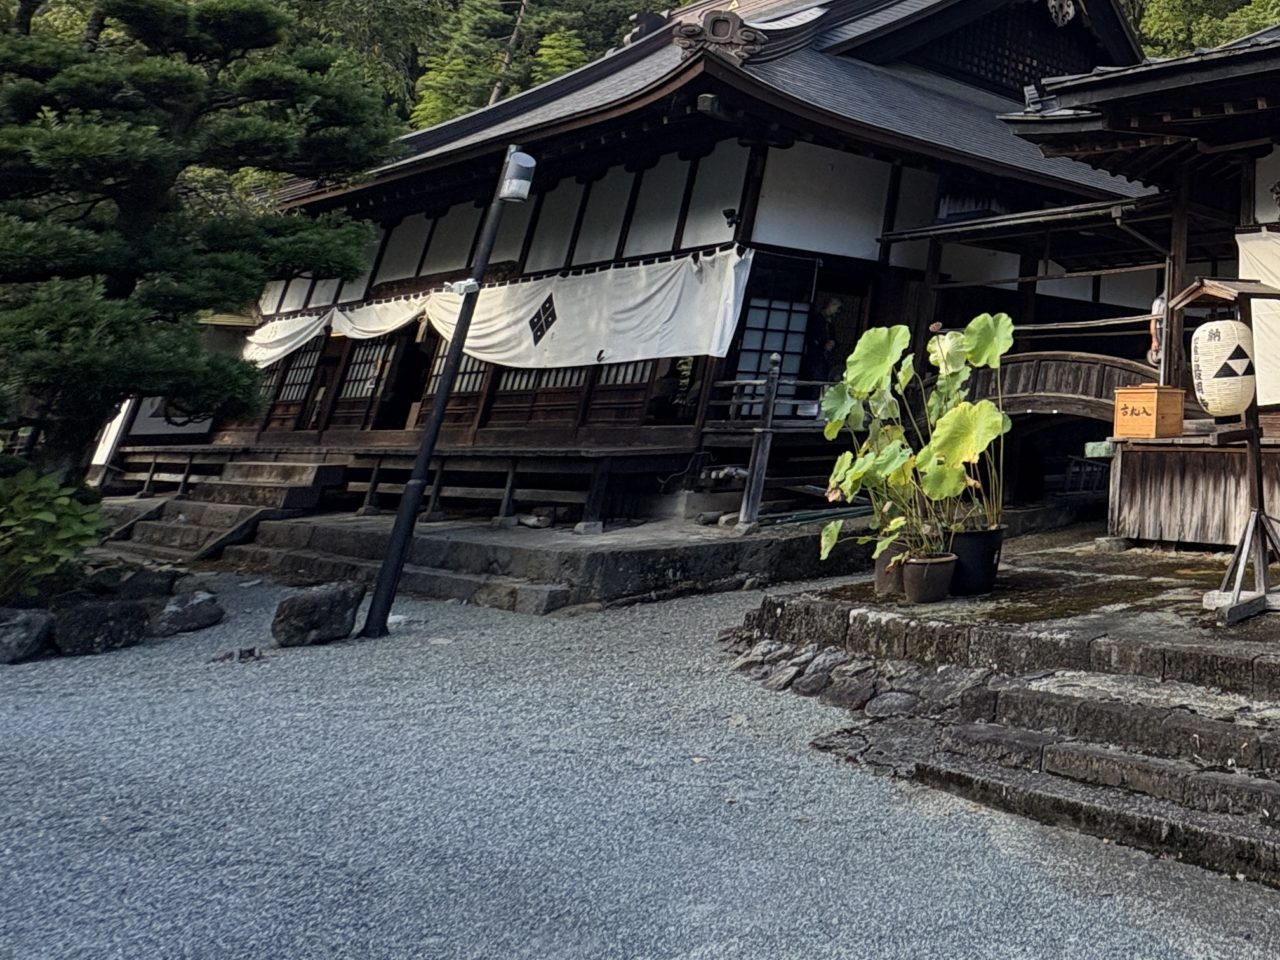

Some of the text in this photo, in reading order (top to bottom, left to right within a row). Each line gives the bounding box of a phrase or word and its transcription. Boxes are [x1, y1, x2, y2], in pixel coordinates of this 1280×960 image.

[1207, 328, 1221, 342] 納
[1120, 403, 1152, 417] 古札入
